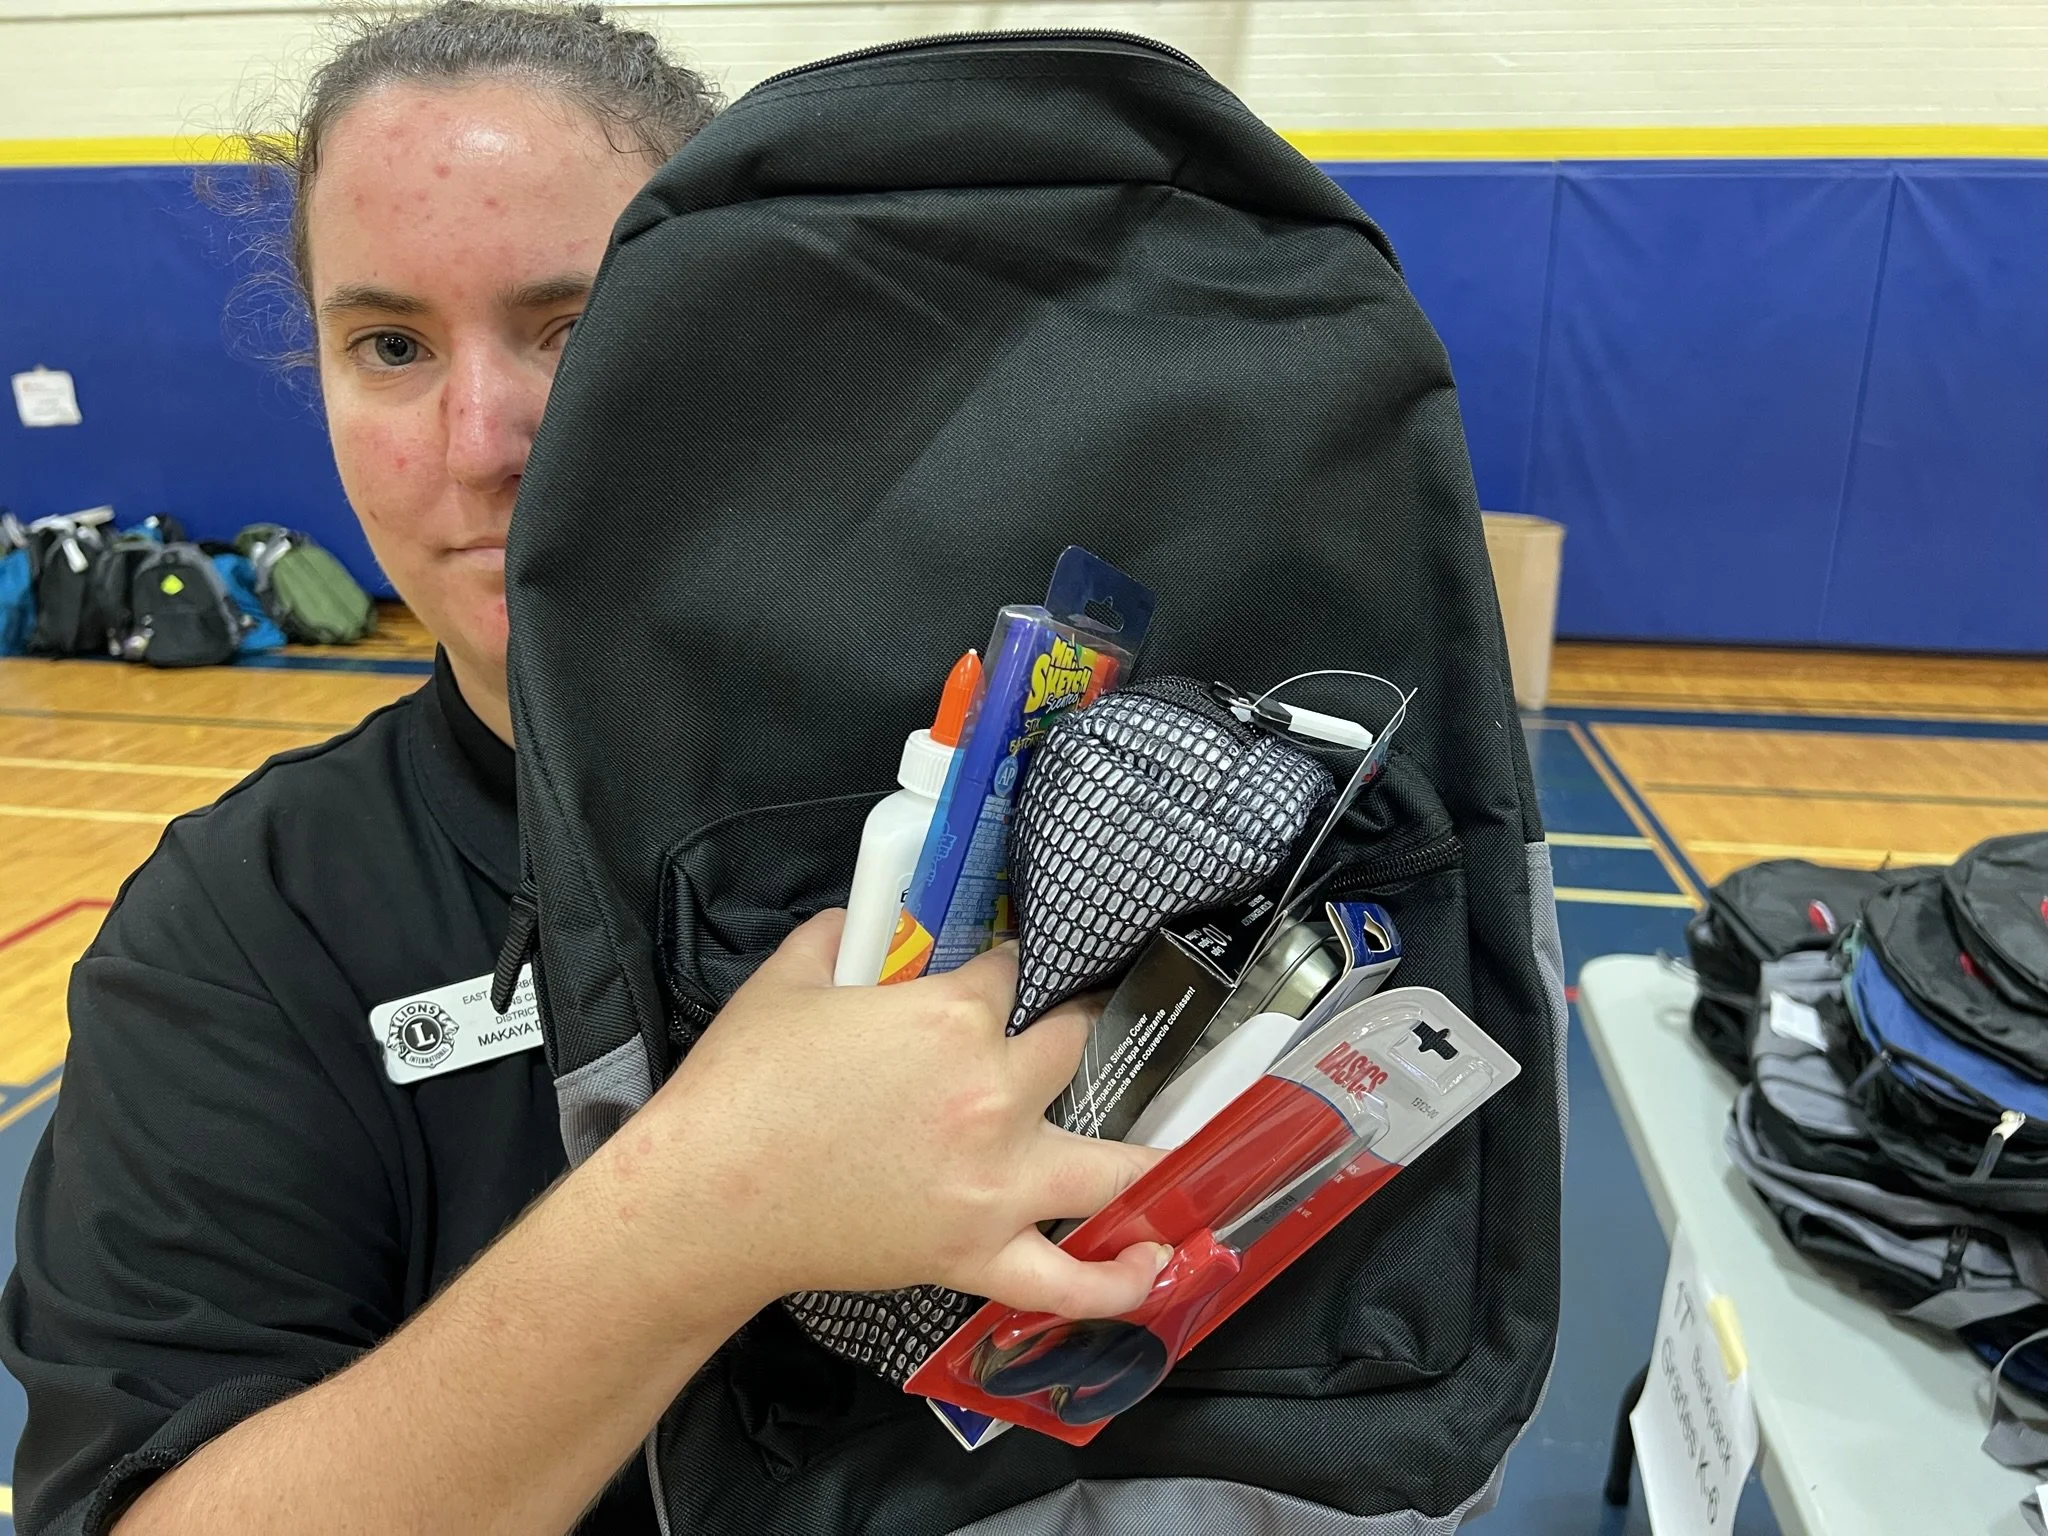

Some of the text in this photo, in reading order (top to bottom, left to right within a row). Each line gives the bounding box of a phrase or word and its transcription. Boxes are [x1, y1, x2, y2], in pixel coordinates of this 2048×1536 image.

[1024, 653, 1093, 714] SKETCH
[997, 766, 1015, 786] AP
[1202, 923, 1232, 946] 10
[462, 990, 488, 1005] EAST
[395, 1004, 437, 1023] LIONS
[496, 1006, 537, 1024] DISTRIC
[411, 1022, 436, 1047] L
[477, 1022, 534, 1047] MAKAYA
[1090, 1078, 1116, 1112] compacta
[1114, 1063, 1127, 1079] con
[1124, 1045, 1140, 1064] tapa
[1138, 1009, 1166, 1046] deslizante
[1104, 1077, 1131, 1112] compacte
[1129, 1060, 1144, 1078] avec
[1142, 1024, 1169, 1060] couvercle
[1167, 985, 1196, 1025] coulissant
[1075, 1079, 1101, 1114] Calculator
[1099, 1063, 1113, 1080] with
[1110, 1036, 1133, 1063] Sliding
[1129, 1013, 1148, 1037] Cover
[1661, 1335, 1697, 1459] Grades
